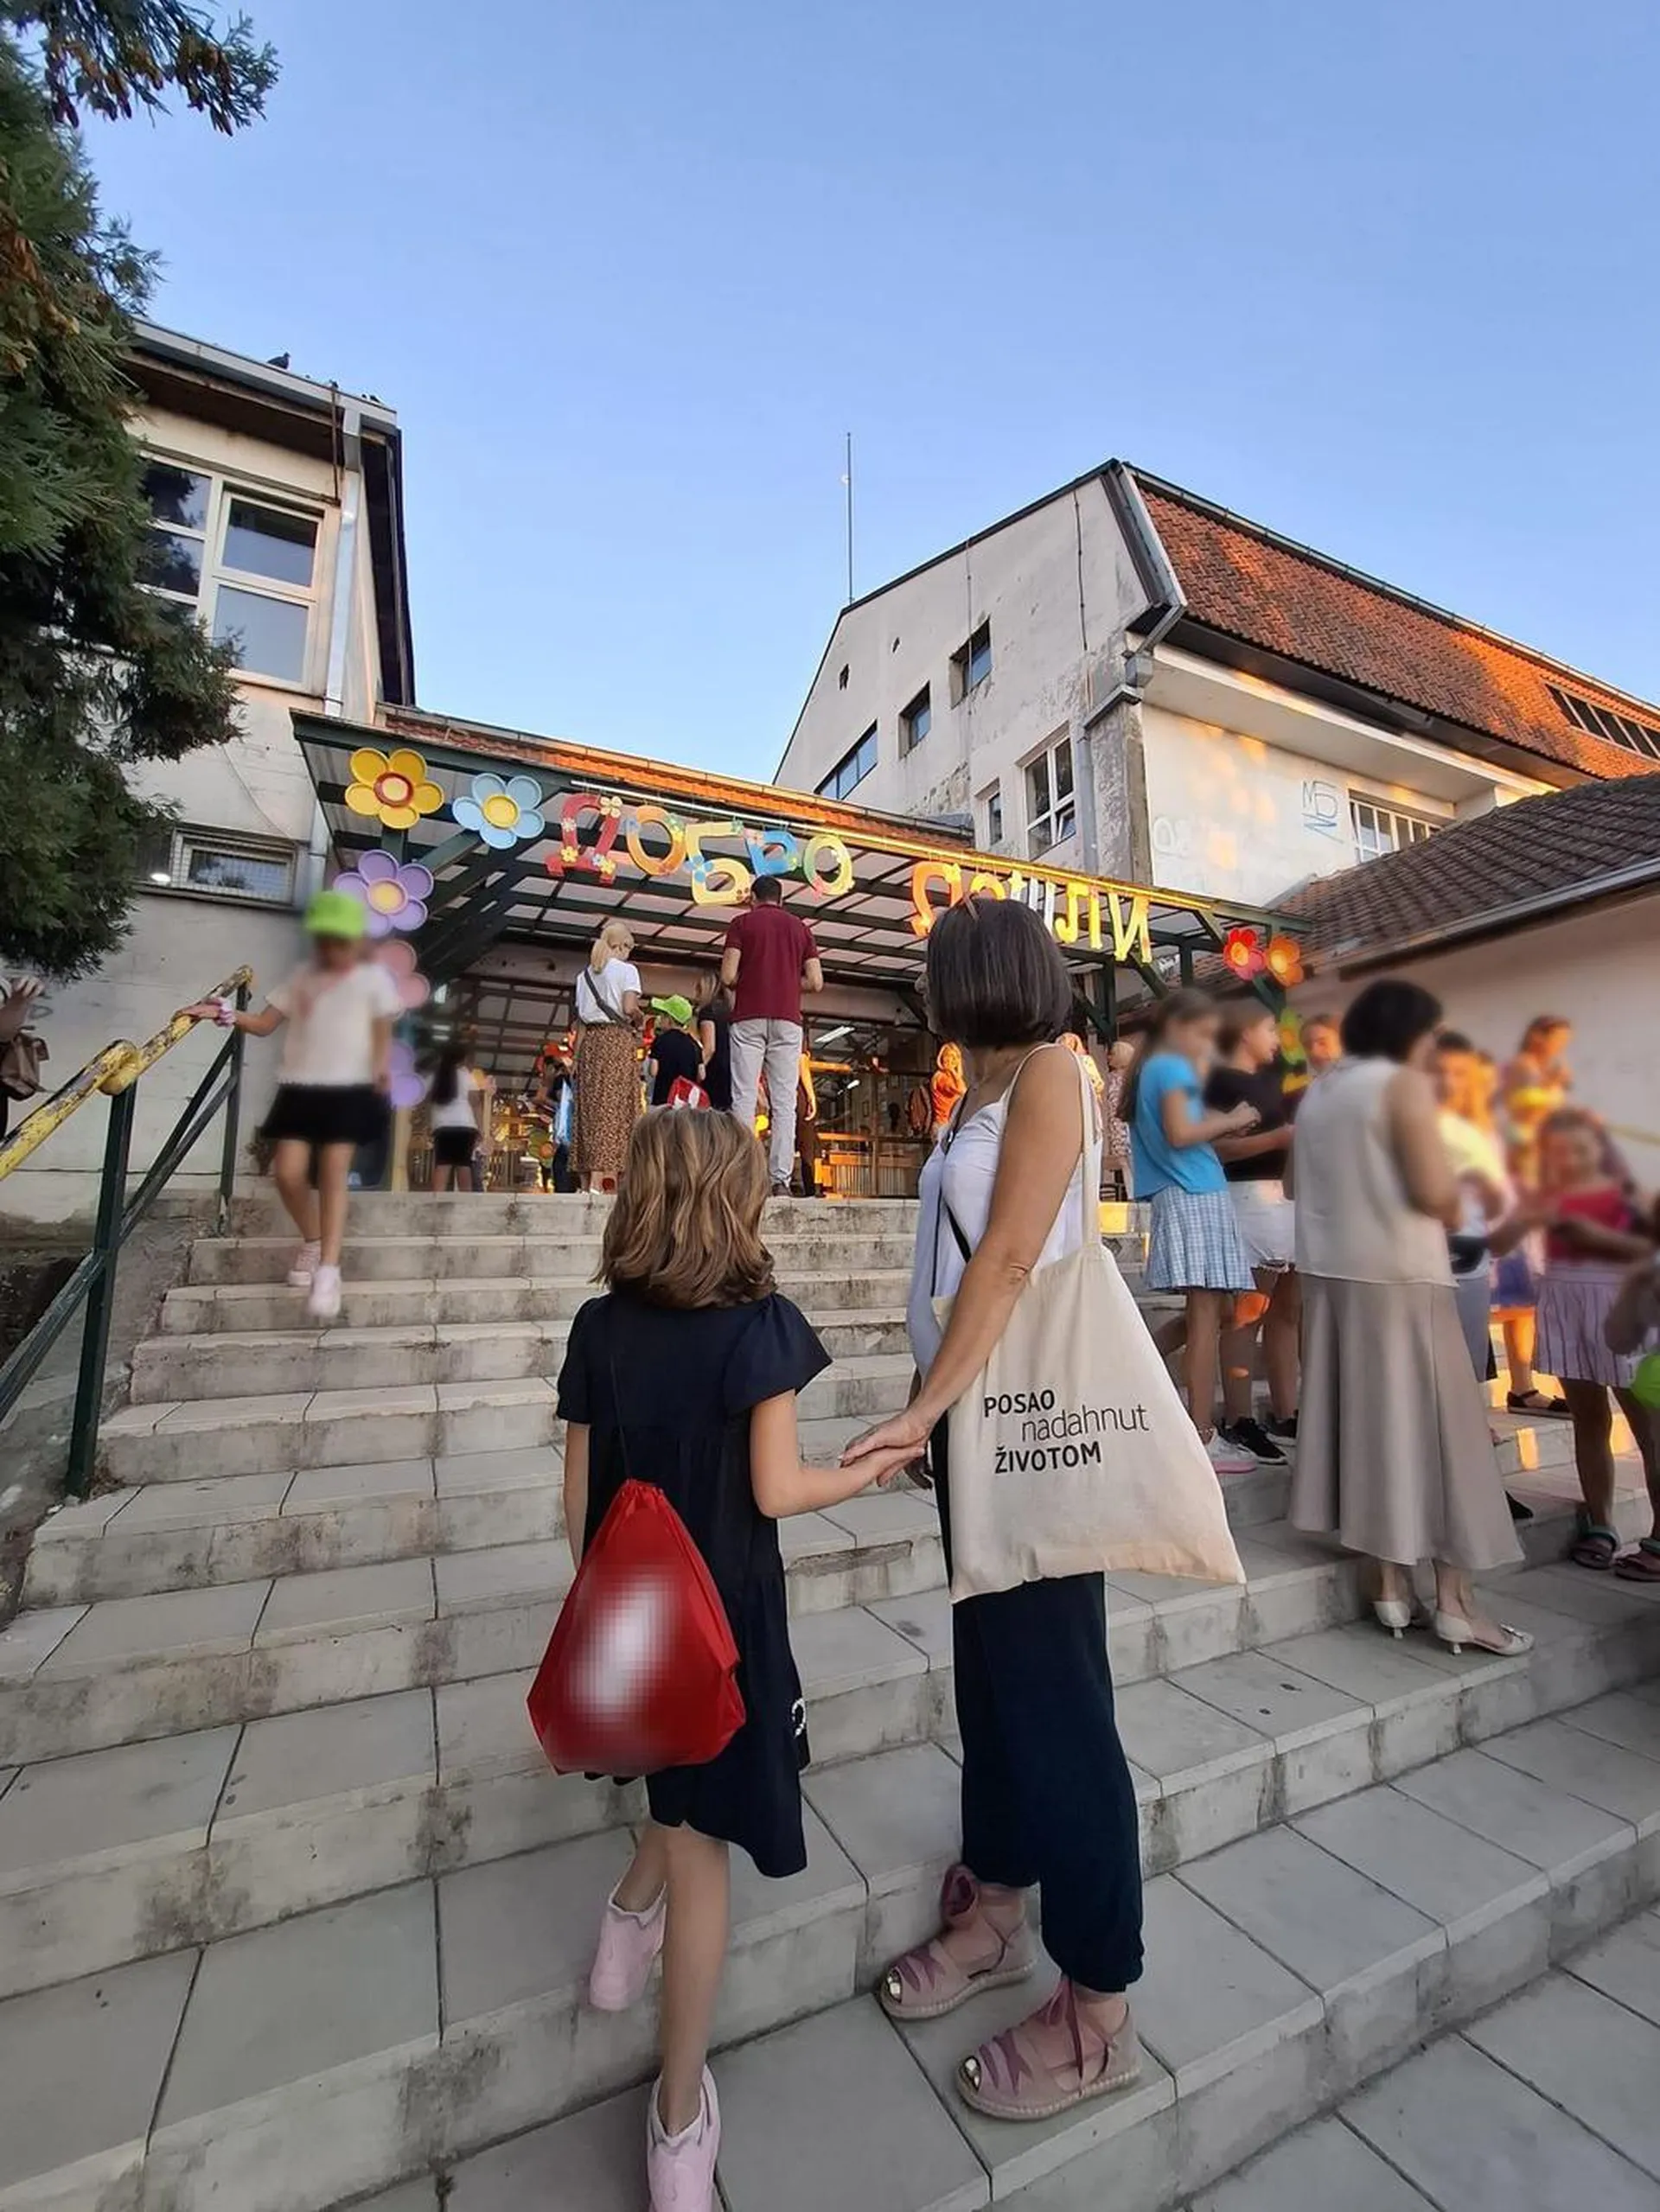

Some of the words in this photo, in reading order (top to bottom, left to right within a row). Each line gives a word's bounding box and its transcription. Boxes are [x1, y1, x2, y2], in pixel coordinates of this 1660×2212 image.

[544, 793, 854, 906] ДОБРО
[984, 1389, 1055, 1418] POSAO
[1022, 1404, 1149, 1442] nadahnut
[995, 1441, 1101, 1474] ŽIVOTOM
